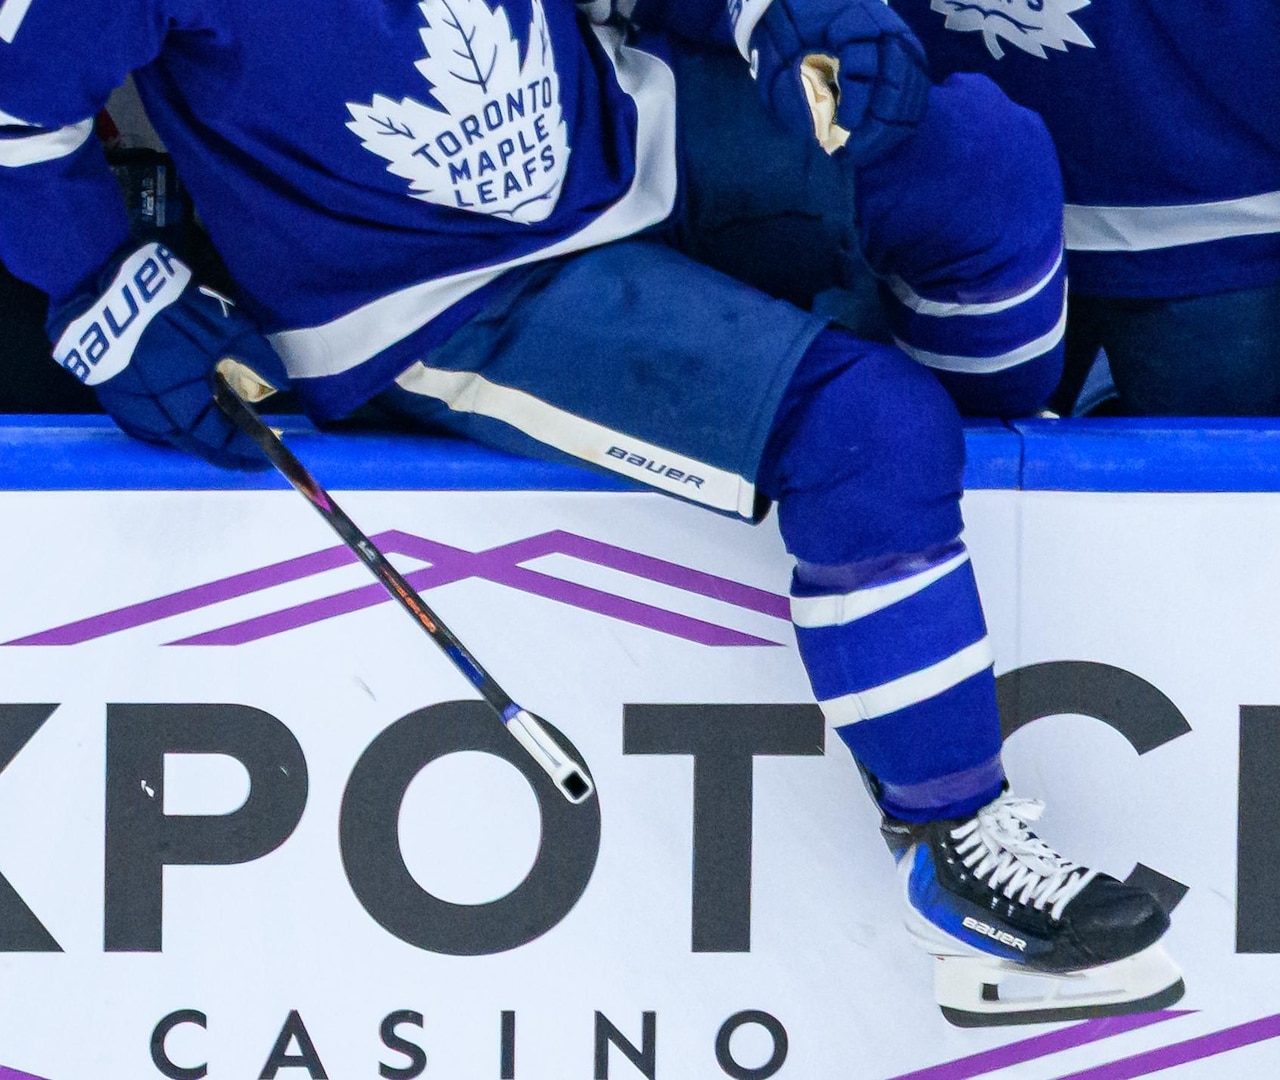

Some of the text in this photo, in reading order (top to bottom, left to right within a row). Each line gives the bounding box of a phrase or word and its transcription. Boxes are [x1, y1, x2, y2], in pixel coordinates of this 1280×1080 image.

[411, 76, 552, 168] TORONTO
[448, 114, 550, 185] MAPLE
[454, 144, 556, 208] LEAFS
[605, 445, 706, 490] BAUER
[962, 916, 1027, 951] BAUER
[149, 1008, 790, 1080] CASINO
